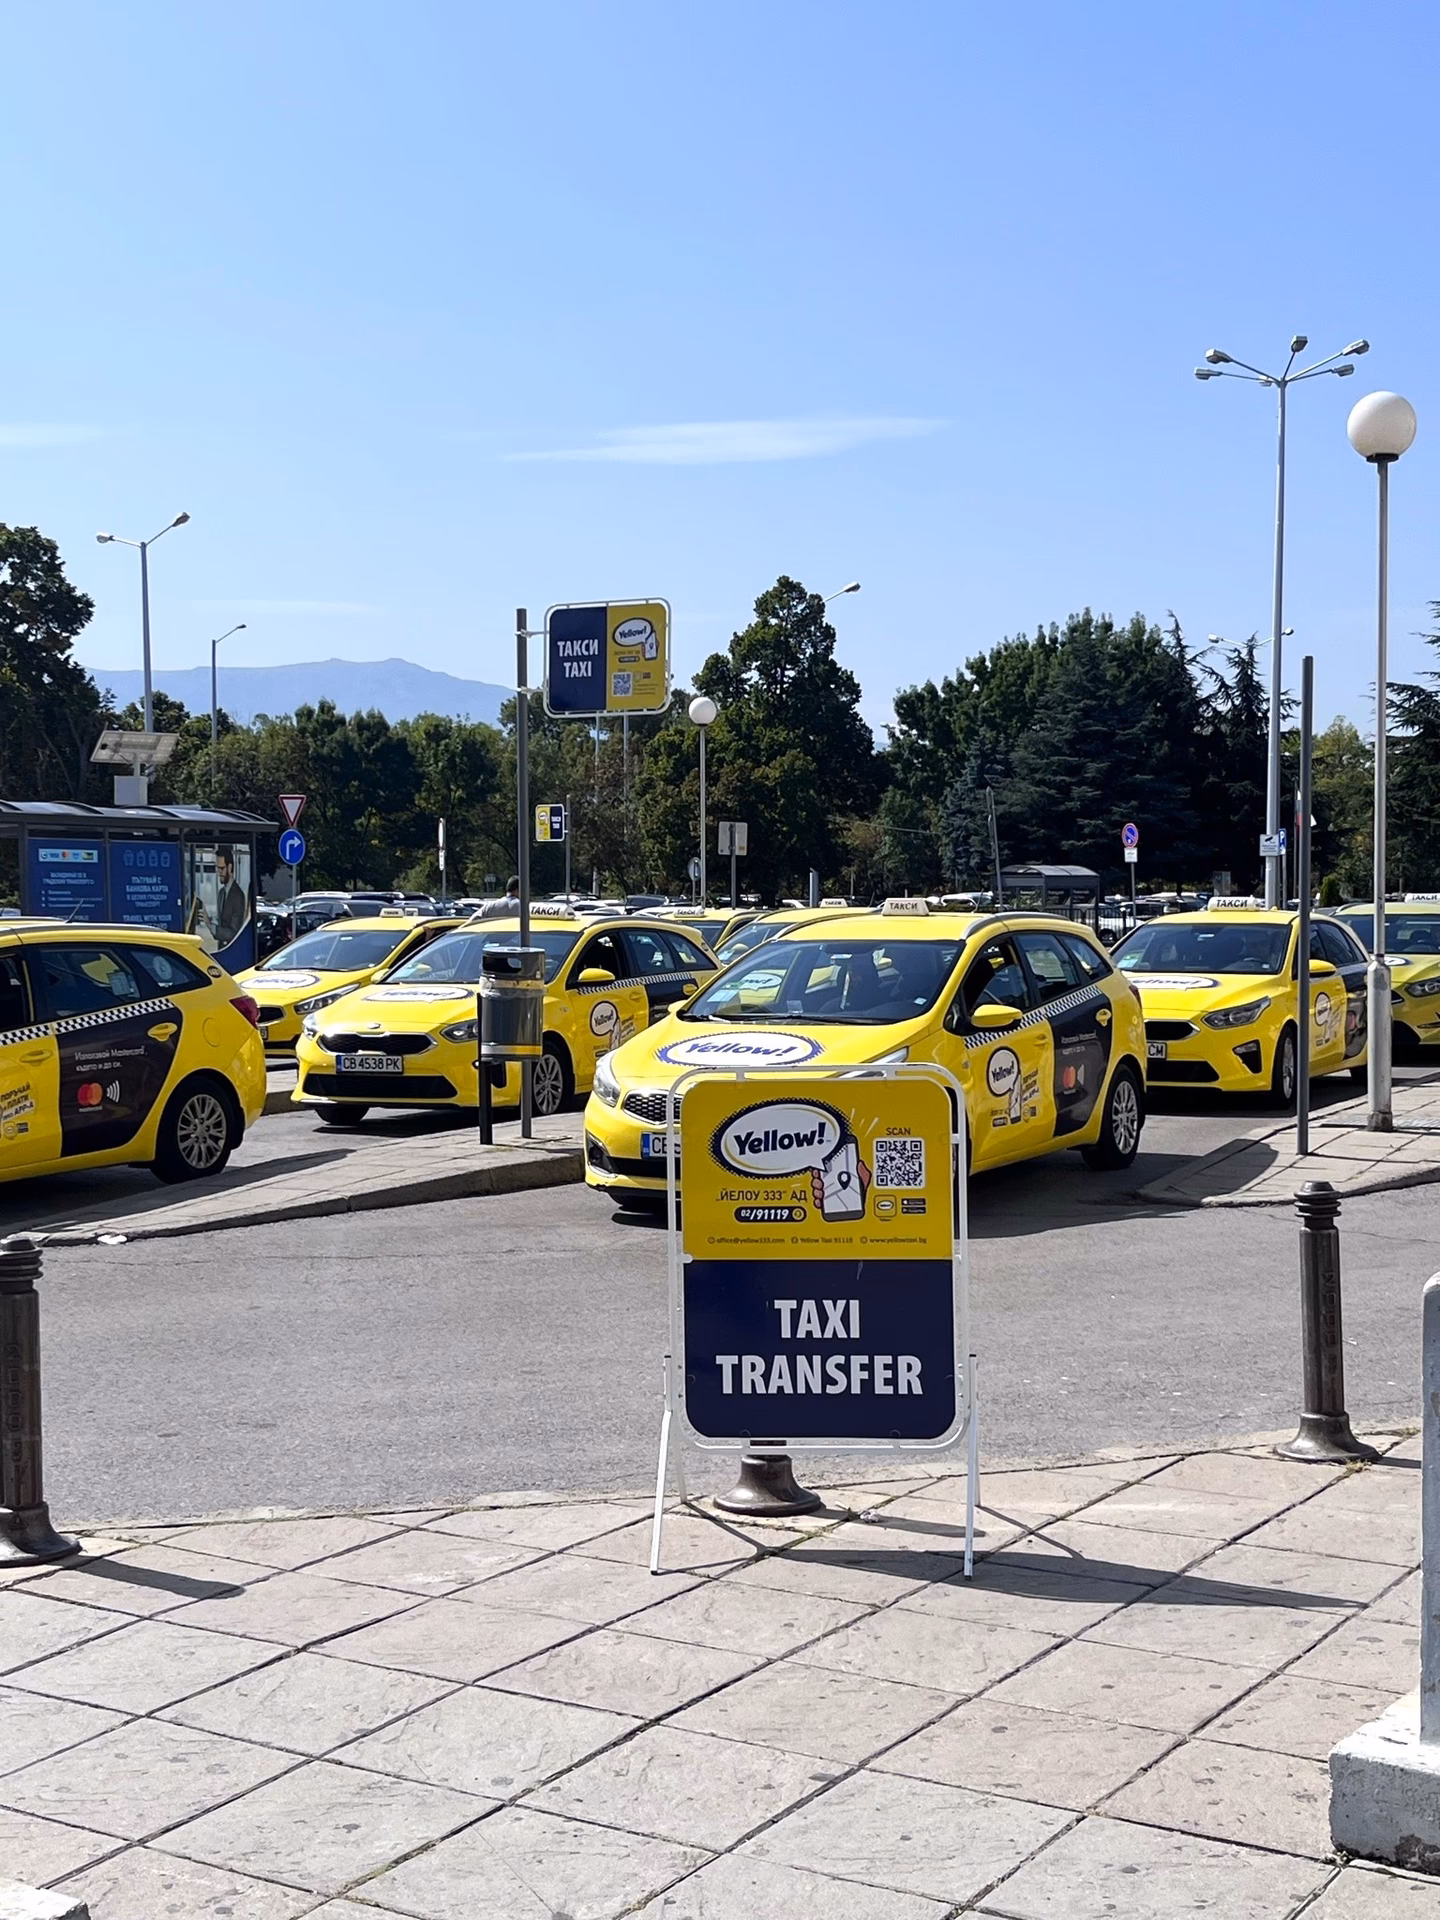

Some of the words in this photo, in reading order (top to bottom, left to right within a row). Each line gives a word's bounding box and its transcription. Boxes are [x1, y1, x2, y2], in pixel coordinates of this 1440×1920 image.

[619, 626, 647, 639] Yellow!
[557, 639, 599, 657] ТАКСИ
[563, 661, 592, 678] TAXI
[889, 902, 918, 910] ТАКСИ
[1216, 899, 1248, 908] ТАКСИ
[531, 905, 560, 916] ТАКСИ
[685, 1042, 799, 1057] Yellow!
[358, 1057, 384, 1070] 4538
[992, 1060, 1015, 1083] Yellow!
[885, 1127, 911, 1136] SCAN
[733, 1122, 827, 1156] Yellow!
[790, 1190, 808, 1203] АД
[740, 1209, 790, 1220] 02/91119
[774, 1299, 861, 1339] TAXI
[715, 1354, 924, 1395] TRANSFER
